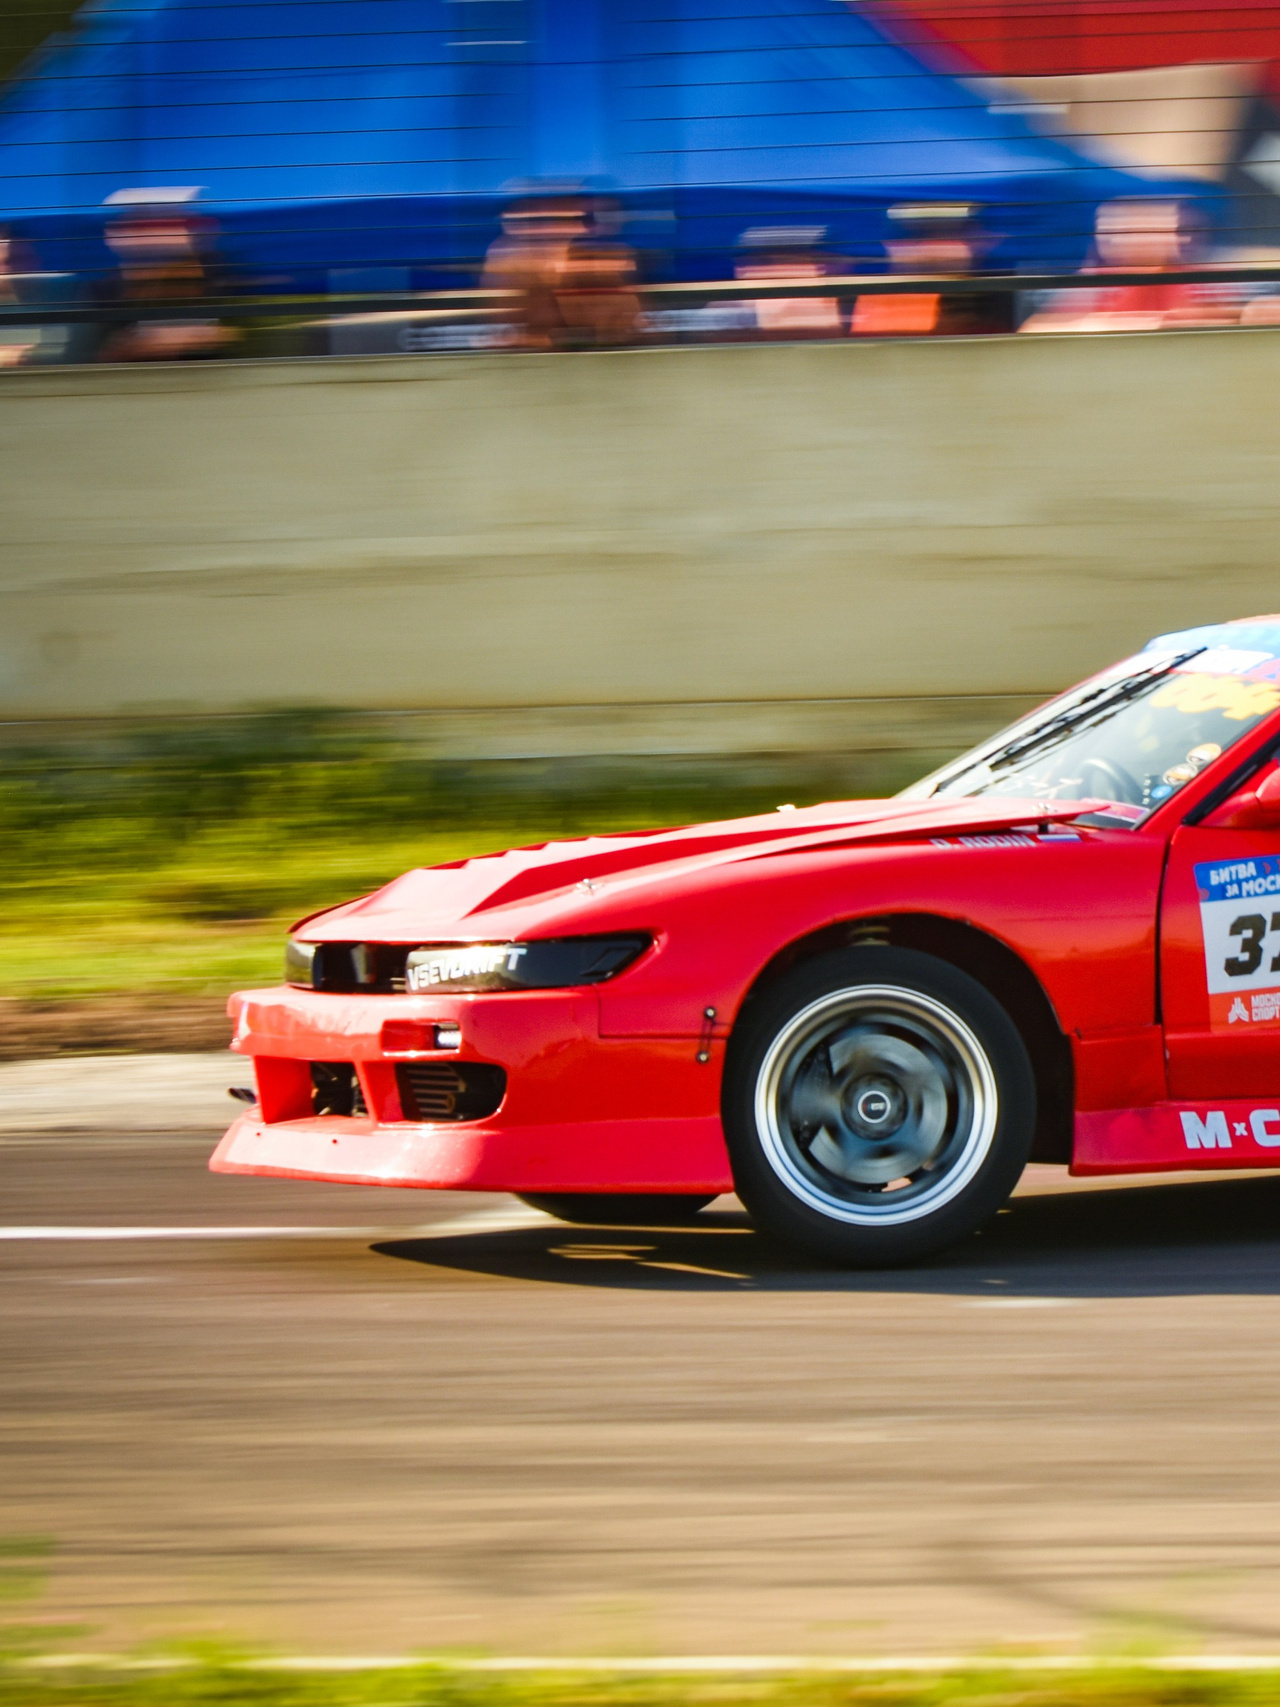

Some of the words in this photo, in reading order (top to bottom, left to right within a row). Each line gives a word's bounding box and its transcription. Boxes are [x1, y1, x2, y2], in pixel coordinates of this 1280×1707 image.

[1210, 861, 1257, 886] БИТВА
[1225, 883, 1239, 898] ЗА
[1251, 1005, 1280, 1022] СПОРТ
